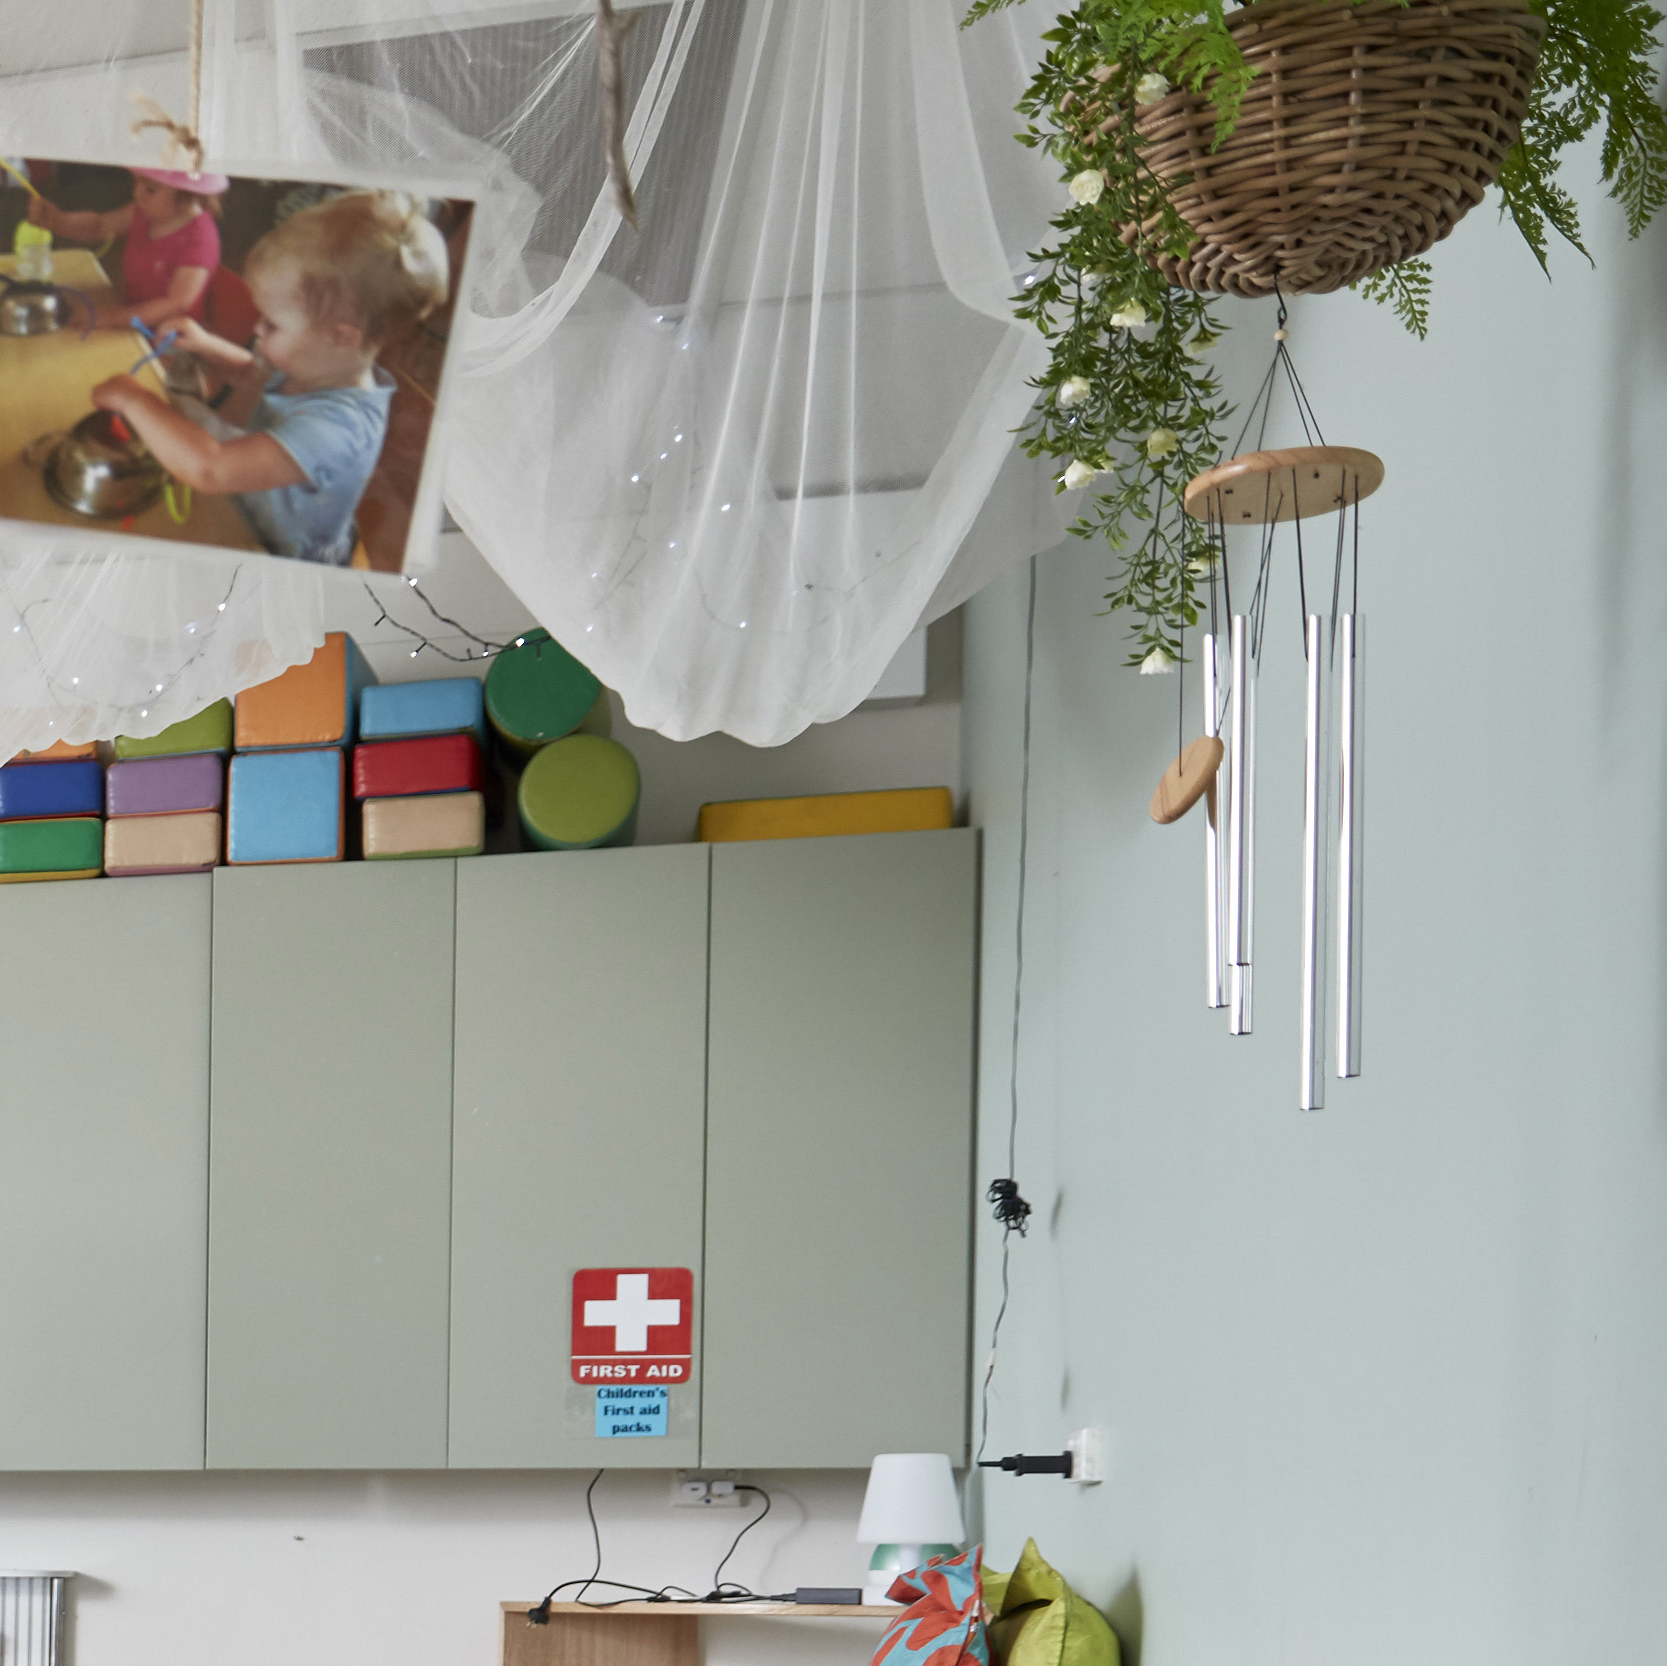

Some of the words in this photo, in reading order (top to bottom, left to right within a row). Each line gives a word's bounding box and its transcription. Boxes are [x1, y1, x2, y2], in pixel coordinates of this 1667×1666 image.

[579, 1365, 640, 1378] FIRST
[646, 1364, 683, 1378] AID
[597, 1387, 668, 1399] Children's
[603, 1405, 634, 1416] First
[639, 1404, 660, 1415] aid
[612, 1421, 652, 1436] packs
